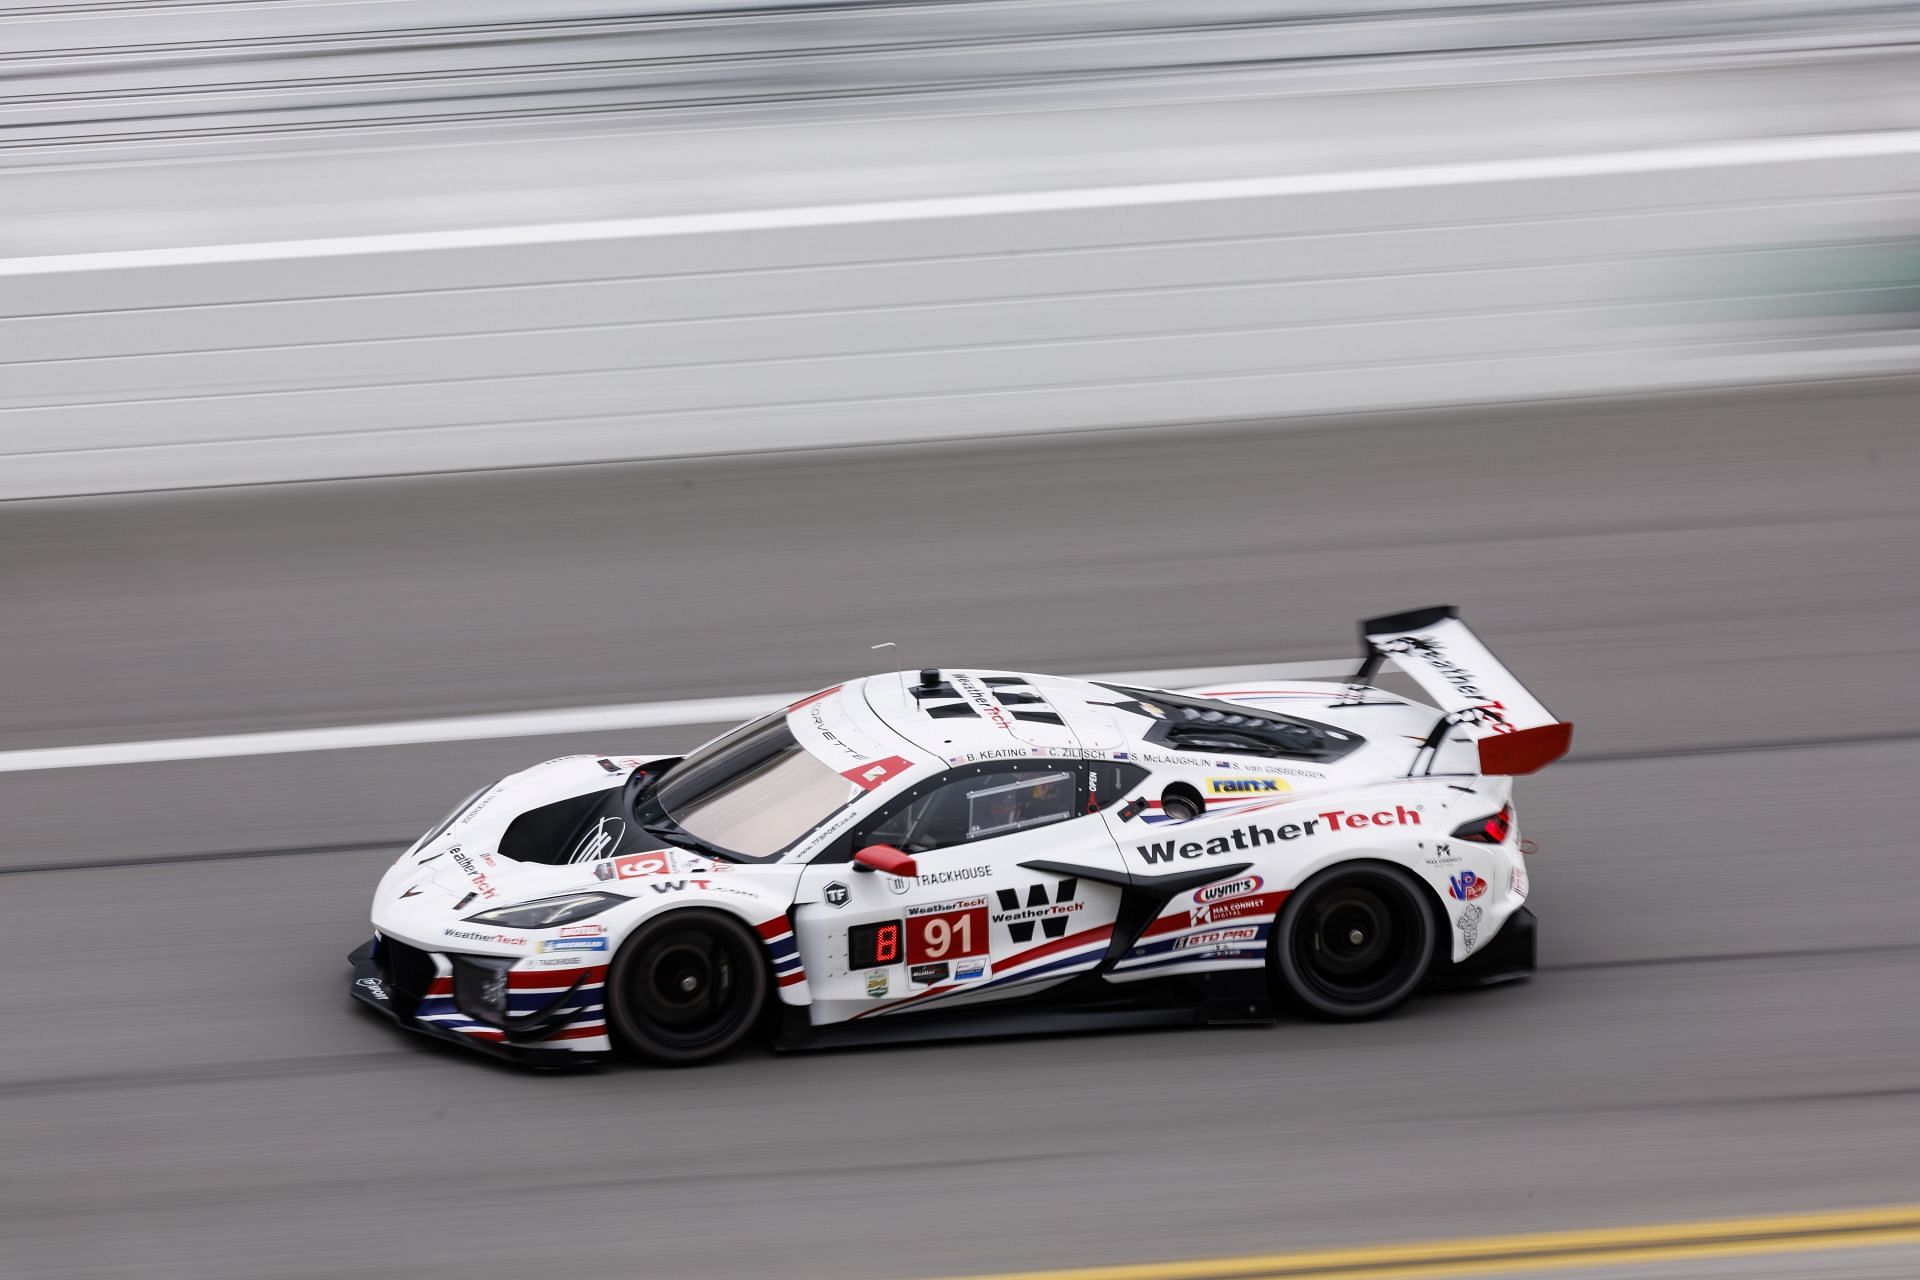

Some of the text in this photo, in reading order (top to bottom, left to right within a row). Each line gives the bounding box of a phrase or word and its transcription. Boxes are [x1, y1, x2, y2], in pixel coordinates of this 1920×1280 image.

[980, 748, 1027, 760] KEATING
[1137, 805, 1422, 865] WeatherTech
[915, 864, 993, 887] TRACKHOUSE
[826, 889, 846, 902] TF
[1449, 871, 1476, 901] VP
[908, 898, 985, 916] WeatherTech
[992, 901, 1085, 923] WeatherTech
[1212, 899, 1264, 914] MAX CONNECT
[443, 927, 528, 946] WeatherTech
[876, 924, 897, 962] 8
[923, 912, 972, 959] 91
[1222, 928, 1255, 940] PRO
